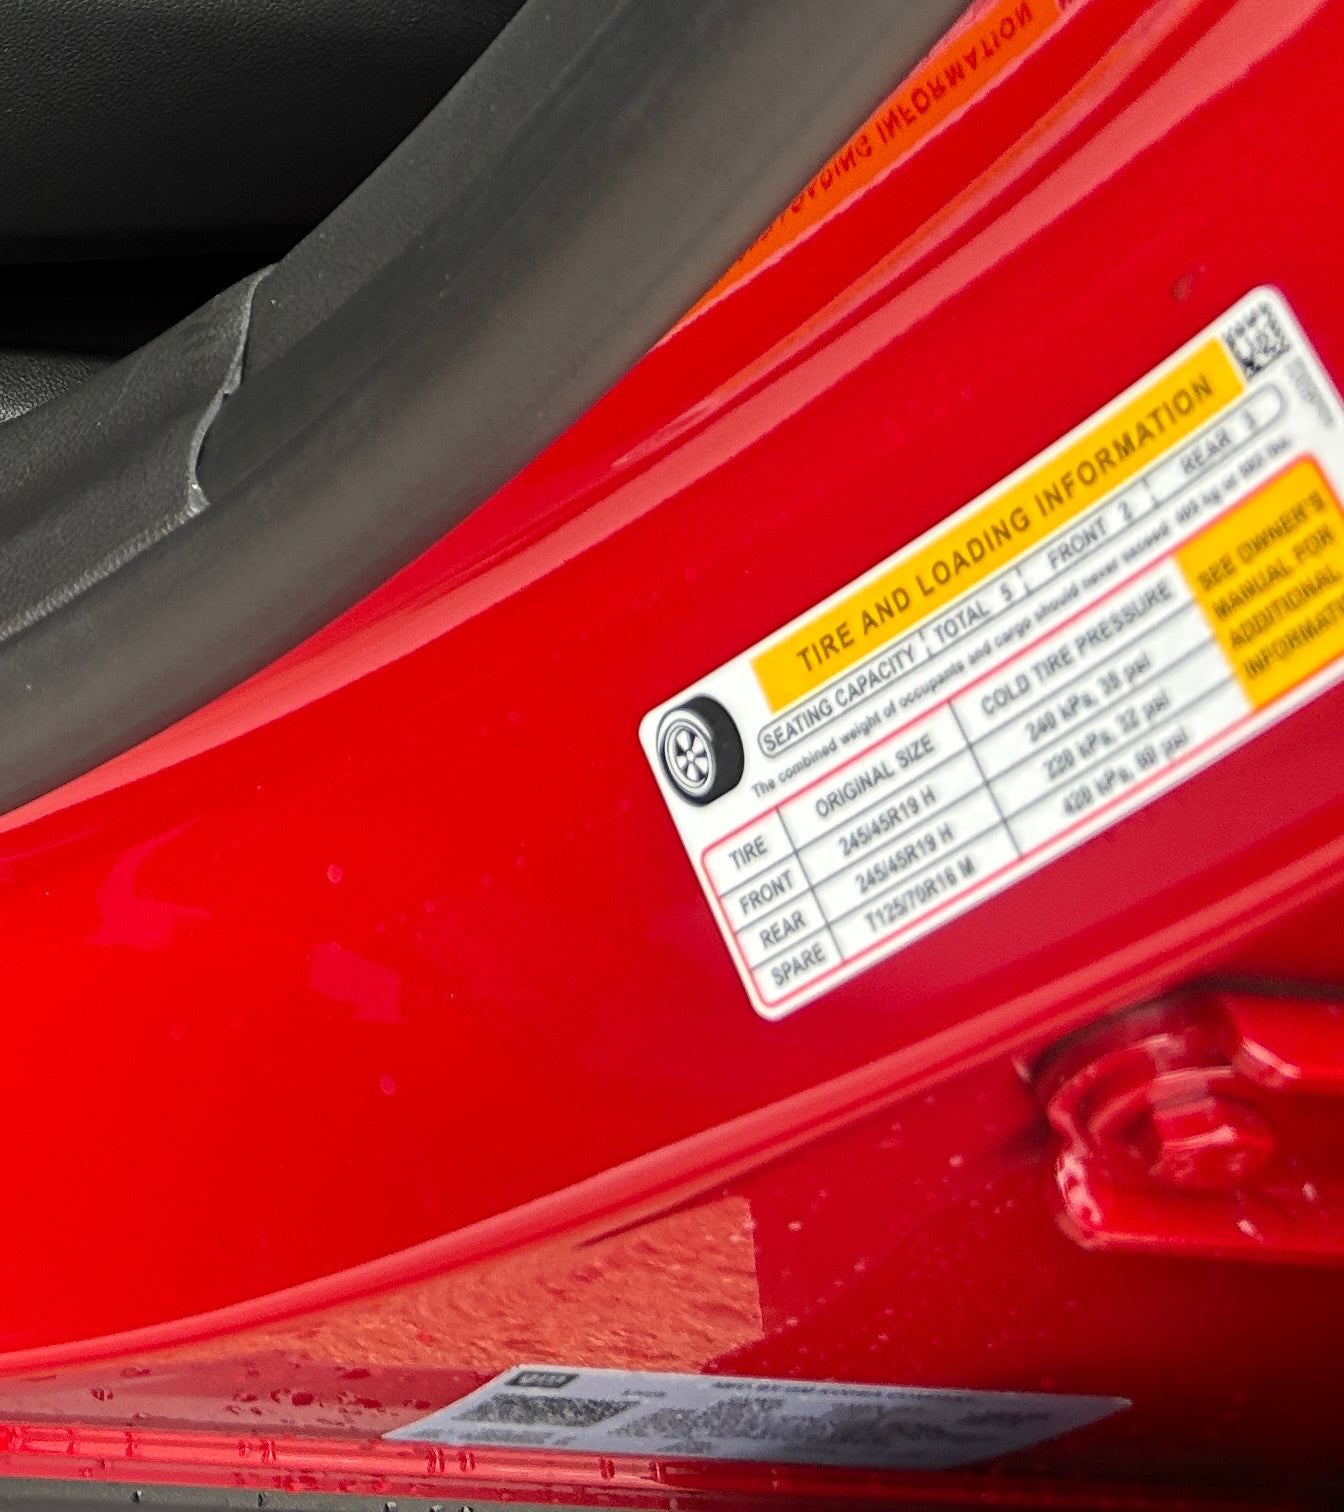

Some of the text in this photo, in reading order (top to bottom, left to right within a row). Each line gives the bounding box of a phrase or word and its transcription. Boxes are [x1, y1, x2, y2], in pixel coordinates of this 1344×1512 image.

[1180, 428, 1232, 475] REAR
[796, 622, 856, 672] TIRE
[858, 588, 912, 635] AND
[914, 507, 1031, 597] LOADING
[1034, 373, 1214, 517] INFORMATION
[1046, 516, 1107, 570] FRONT
[1117, 500, 1133, 522] 2
[932, 583, 1013, 644] TOTAL 5
[979, 581, 1174, 717] COLD TIRE PRESSURE
[751, 777, 776, 799] The
[778, 739, 838, 784] combined
[840, 709, 881, 746] weight
[882, 698, 898, 717] of
[899, 659, 964, 709] occupants
[967, 641, 992, 664] and
[994, 618, 1033, 650] cargo
[763, 644, 917, 752] SEATING CAPACITY
[815, 732, 935, 819] ORIGINAL SIZE
[728, 835, 770, 871] TIRE
[838, 785, 938, 857] 245/45R19 H
[855, 820, 955, 894] 245/45R19 H
[738, 869, 795, 916] FRONT
[863, 856, 978, 933] T125/70R16 M
[759, 909, 808, 950] REAR
[770, 941, 827, 987] SPARE
